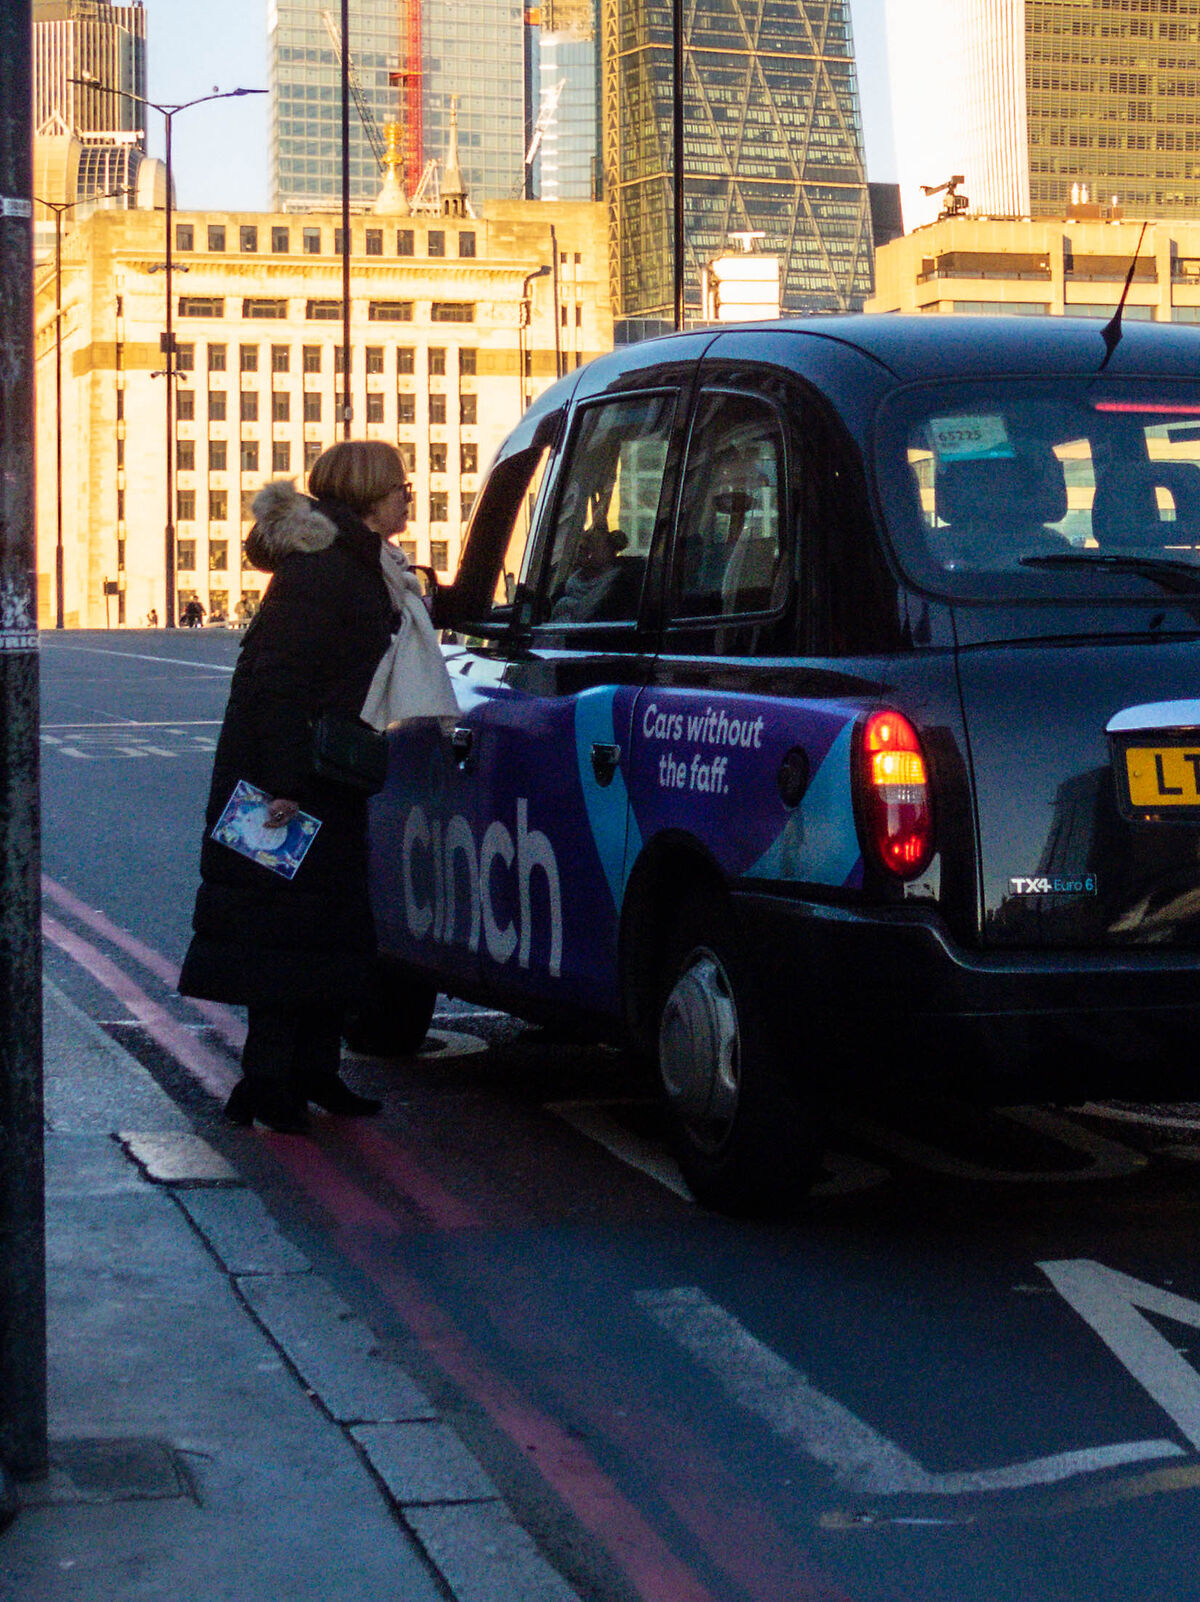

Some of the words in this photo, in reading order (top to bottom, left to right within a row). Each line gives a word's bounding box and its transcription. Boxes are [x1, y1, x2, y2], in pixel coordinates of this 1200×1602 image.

[643, 703, 684, 740] Cars
[687, 706, 764, 748] without
[659, 752, 686, 788] the
[690, 754, 729, 794] faff.
[402, 797, 564, 977] cinch
[1011, 878, 1052, 893] TX4
[1054, 879, 1084, 891] Euro
[1085, 878, 1094, 891] 6
